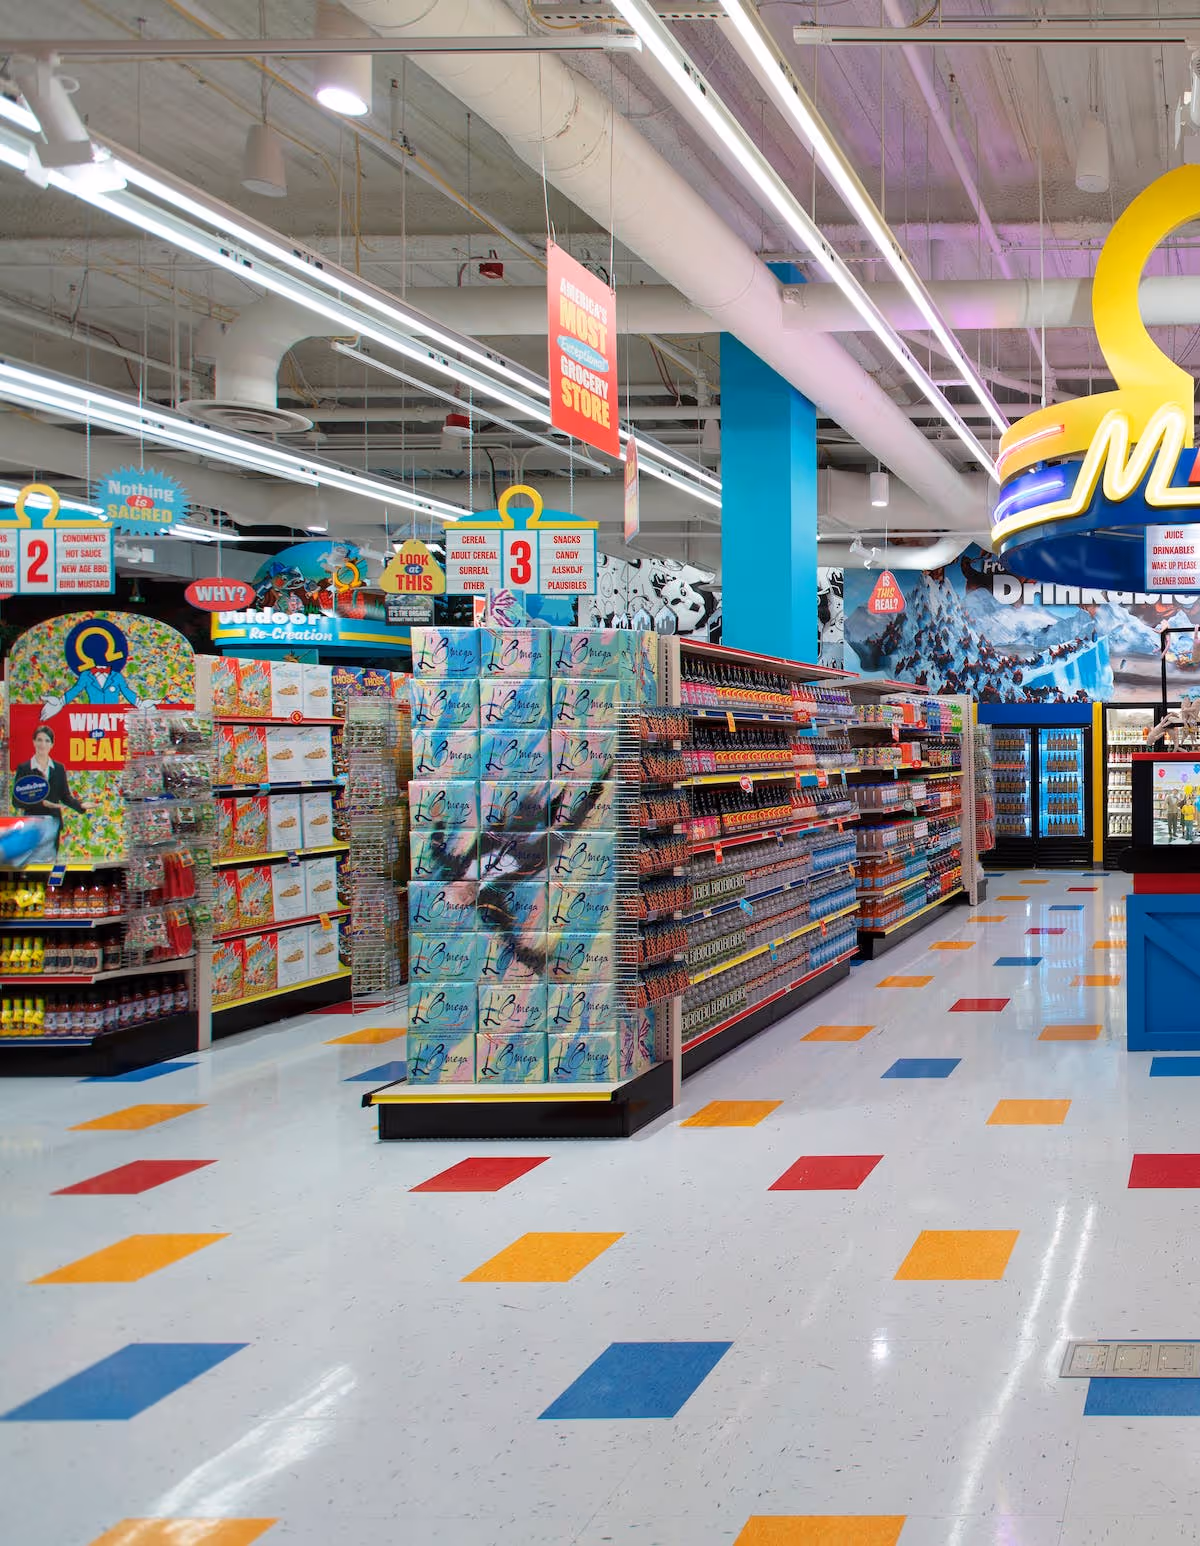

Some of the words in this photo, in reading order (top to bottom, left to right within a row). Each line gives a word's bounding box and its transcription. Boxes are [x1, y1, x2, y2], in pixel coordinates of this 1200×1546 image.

[560, 278, 607, 324] AMERICA'S
[560, 294, 607, 354] MOST
[561, 339, 605, 371] Exceptional
[560, 355, 608, 400] GROCERY
[561, 376, 611, 430] STORE
[108, 480, 174, 502] Nothing
[134, 495, 148, 507] is
[107, 504, 173, 523] SACRED
[62, 534, 106, 543] CONDIMENTS
[1164, 530, 1184, 539] JUICE
[462, 536, 486, 544] CEREAL
[553, 536, 581, 544] SNACKS
[66, 550, 78, 558] HOT
[80, 550, 102, 558] SAUCE
[1152, 546, 1195, 555] DRINKABLES
[27, 539, 48, 583] 2
[400, 554, 429, 566] LOOK
[451, 552, 471, 560] ADULT
[473, 552, 497, 560] CEREAL
[556, 552, 579, 560] CANDY
[510, 540, 532, 585] 3
[1152, 561, 1167, 570] WAKE
[1169, 561, 1176, 570] UP
[1178, 561, 1197, 570] PLEASE
[62, 565, 77, 573] NEW
[78, 565, 92, 573] AGE
[409, 565, 420, 574] at
[459, 566, 489, 575] SURREAL
[60, 580, 75, 588] BIRD
[78, 580, 110, 589] MUSTARD
[396, 574, 433, 592] THIS
[882, 576, 890, 587] IS
[1152, 576, 1177, 585] CLEANER
[1178, 576, 1196, 585] SODAS
[464, 582, 485, 590] OTHER
[548, 582, 587, 590] PLAUSIBLES
[195, 586, 247, 602] WHY?
[877, 588, 896, 598] THIS
[875, 598, 899, 610] REAL?
[249, 628, 333, 642] Re-Creation
